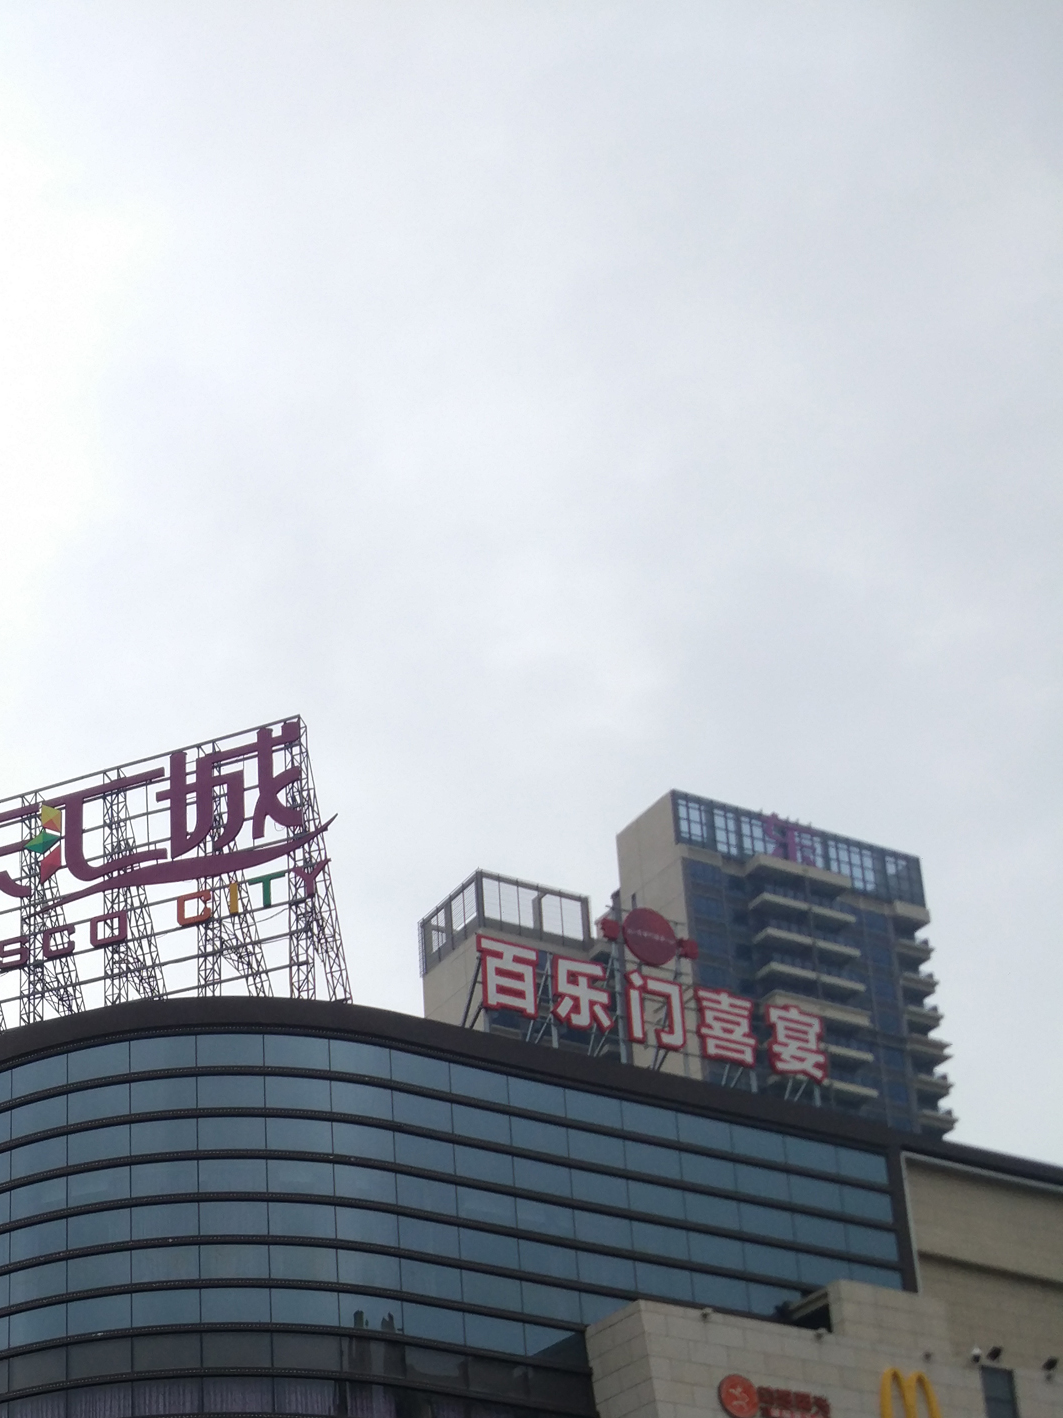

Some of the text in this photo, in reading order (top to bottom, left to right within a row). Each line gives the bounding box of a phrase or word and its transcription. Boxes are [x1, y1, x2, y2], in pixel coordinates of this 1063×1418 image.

[177, 858, 330, 927] CITY
[476, 934, 829, 1084] 百乐门喜宴
